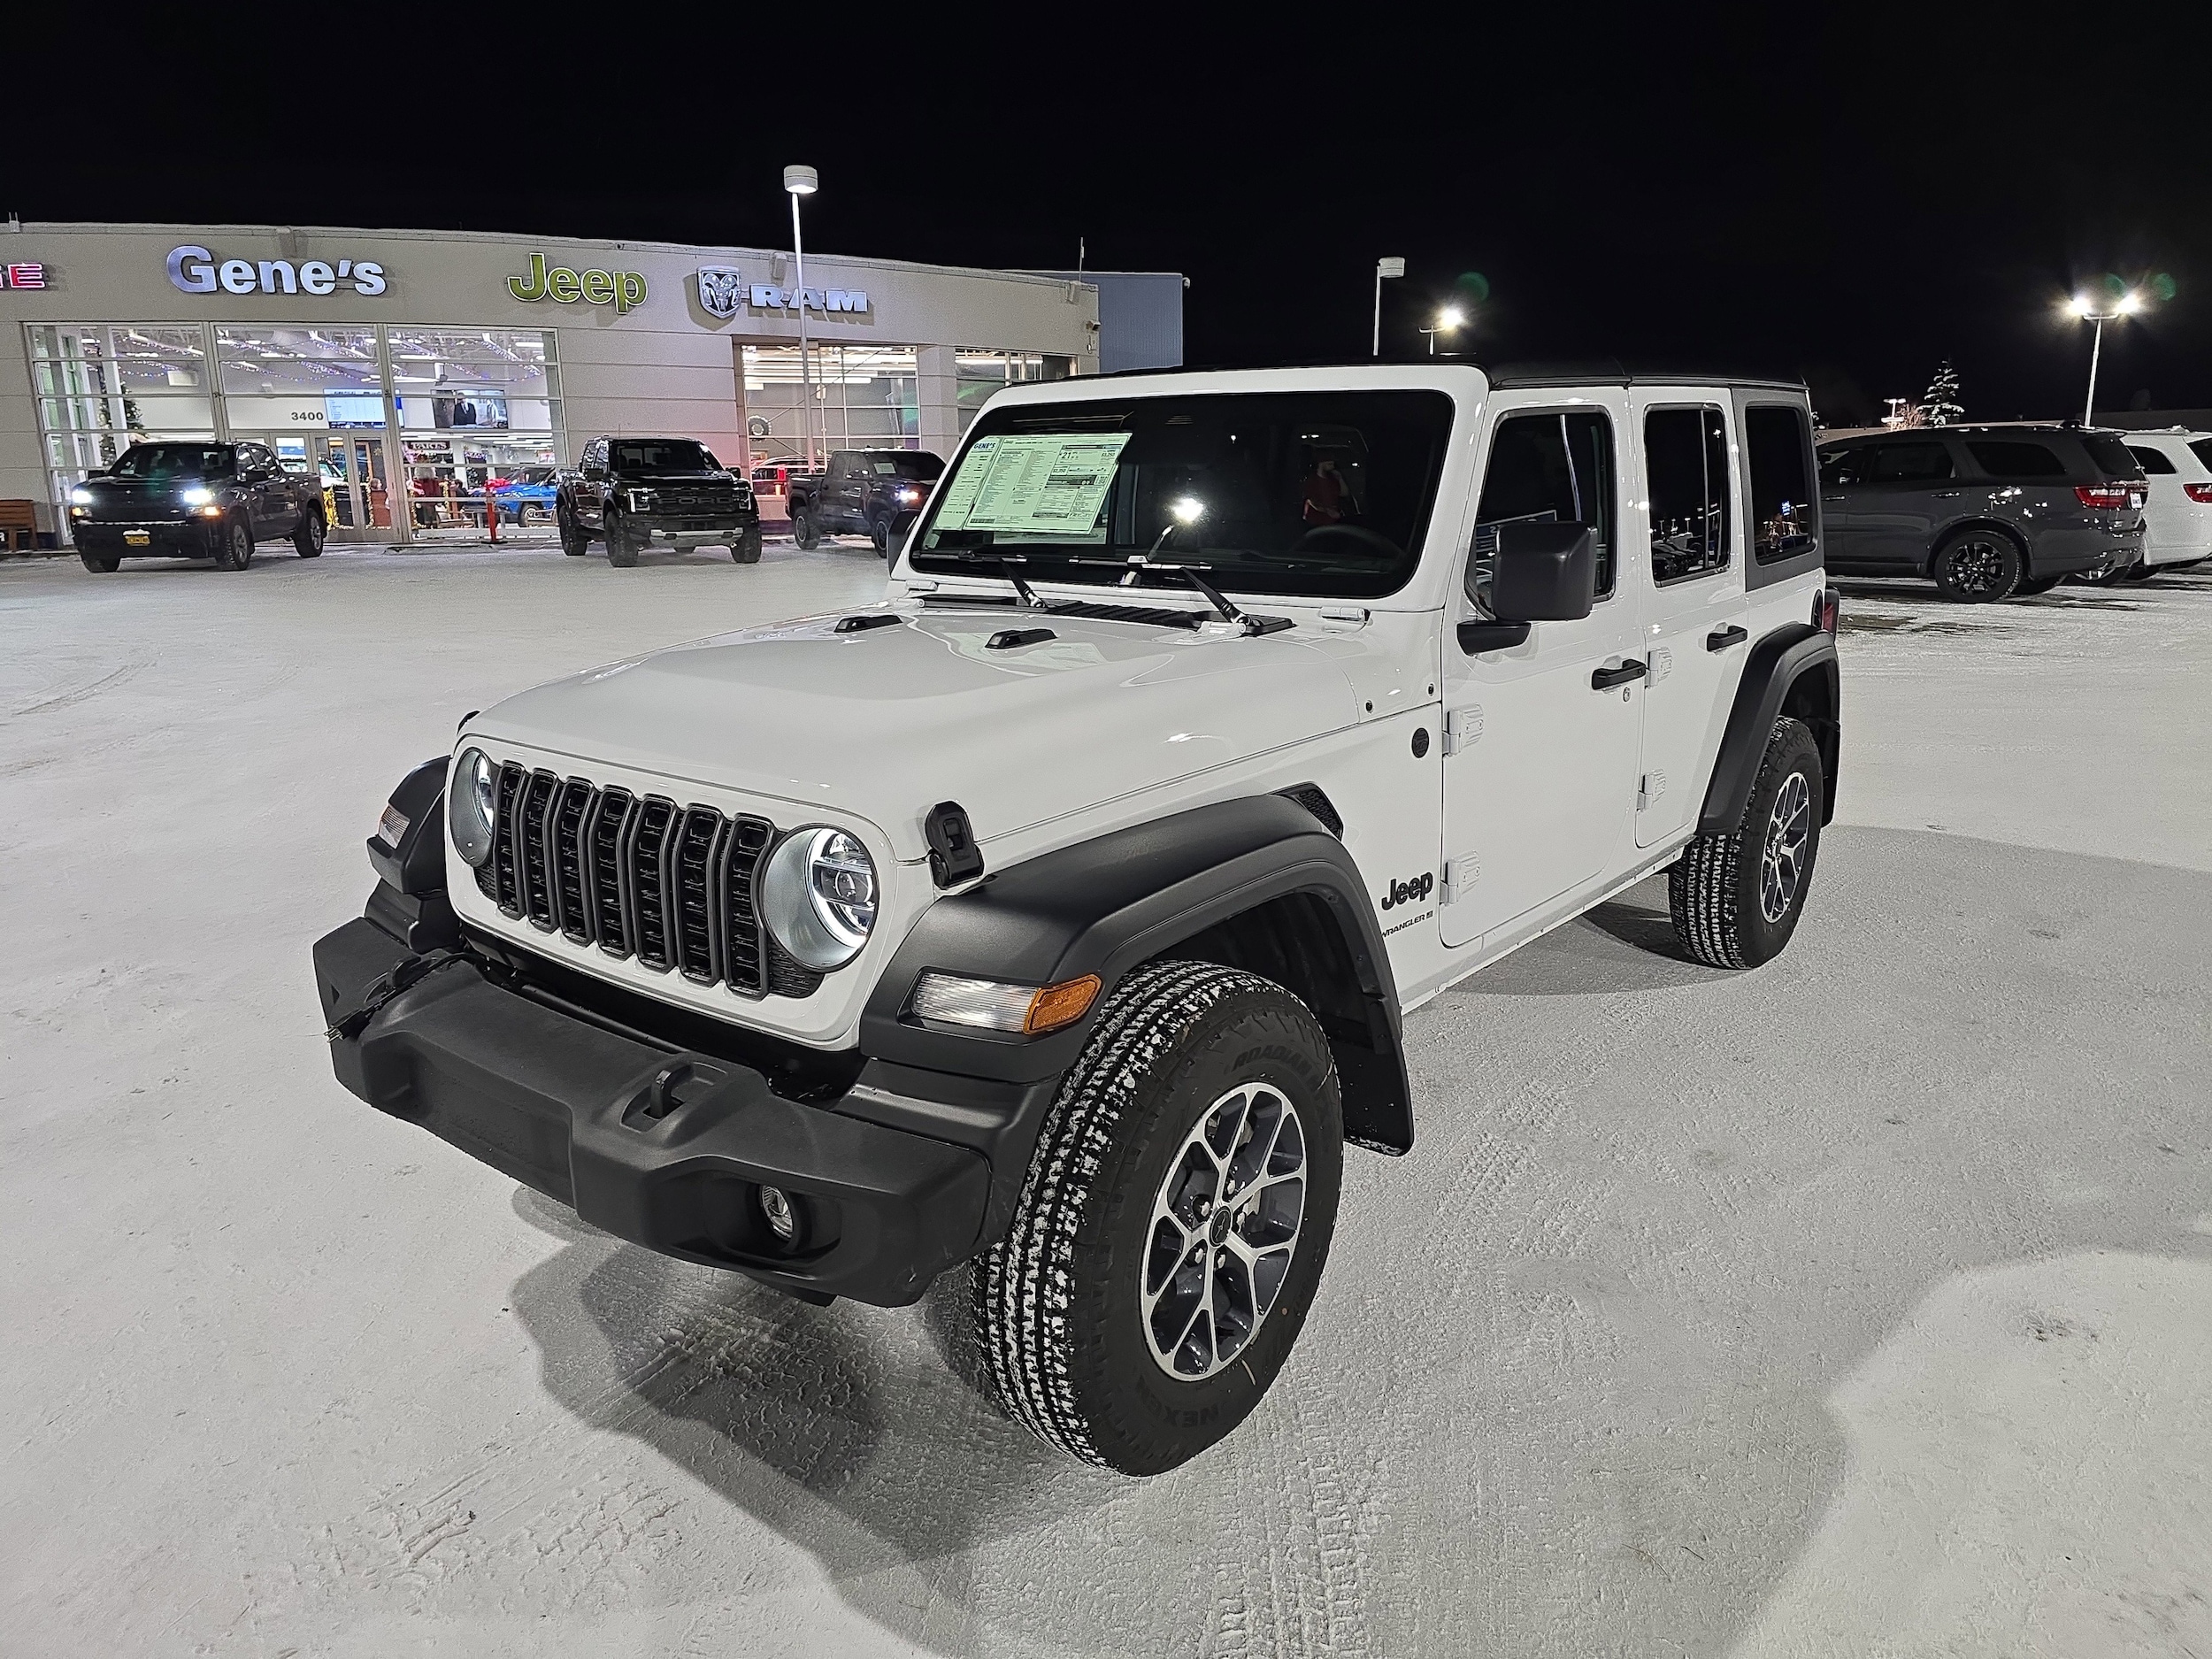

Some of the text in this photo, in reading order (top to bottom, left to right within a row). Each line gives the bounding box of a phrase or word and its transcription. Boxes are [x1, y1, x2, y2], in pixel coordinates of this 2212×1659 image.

[166, 244, 387, 296] Gene's
[507, 252, 648, 314] Jeep
[749, 283, 869, 312] RAM
[290, 411, 324, 421] 3400
[1381, 872, 1433, 911] Jeep
